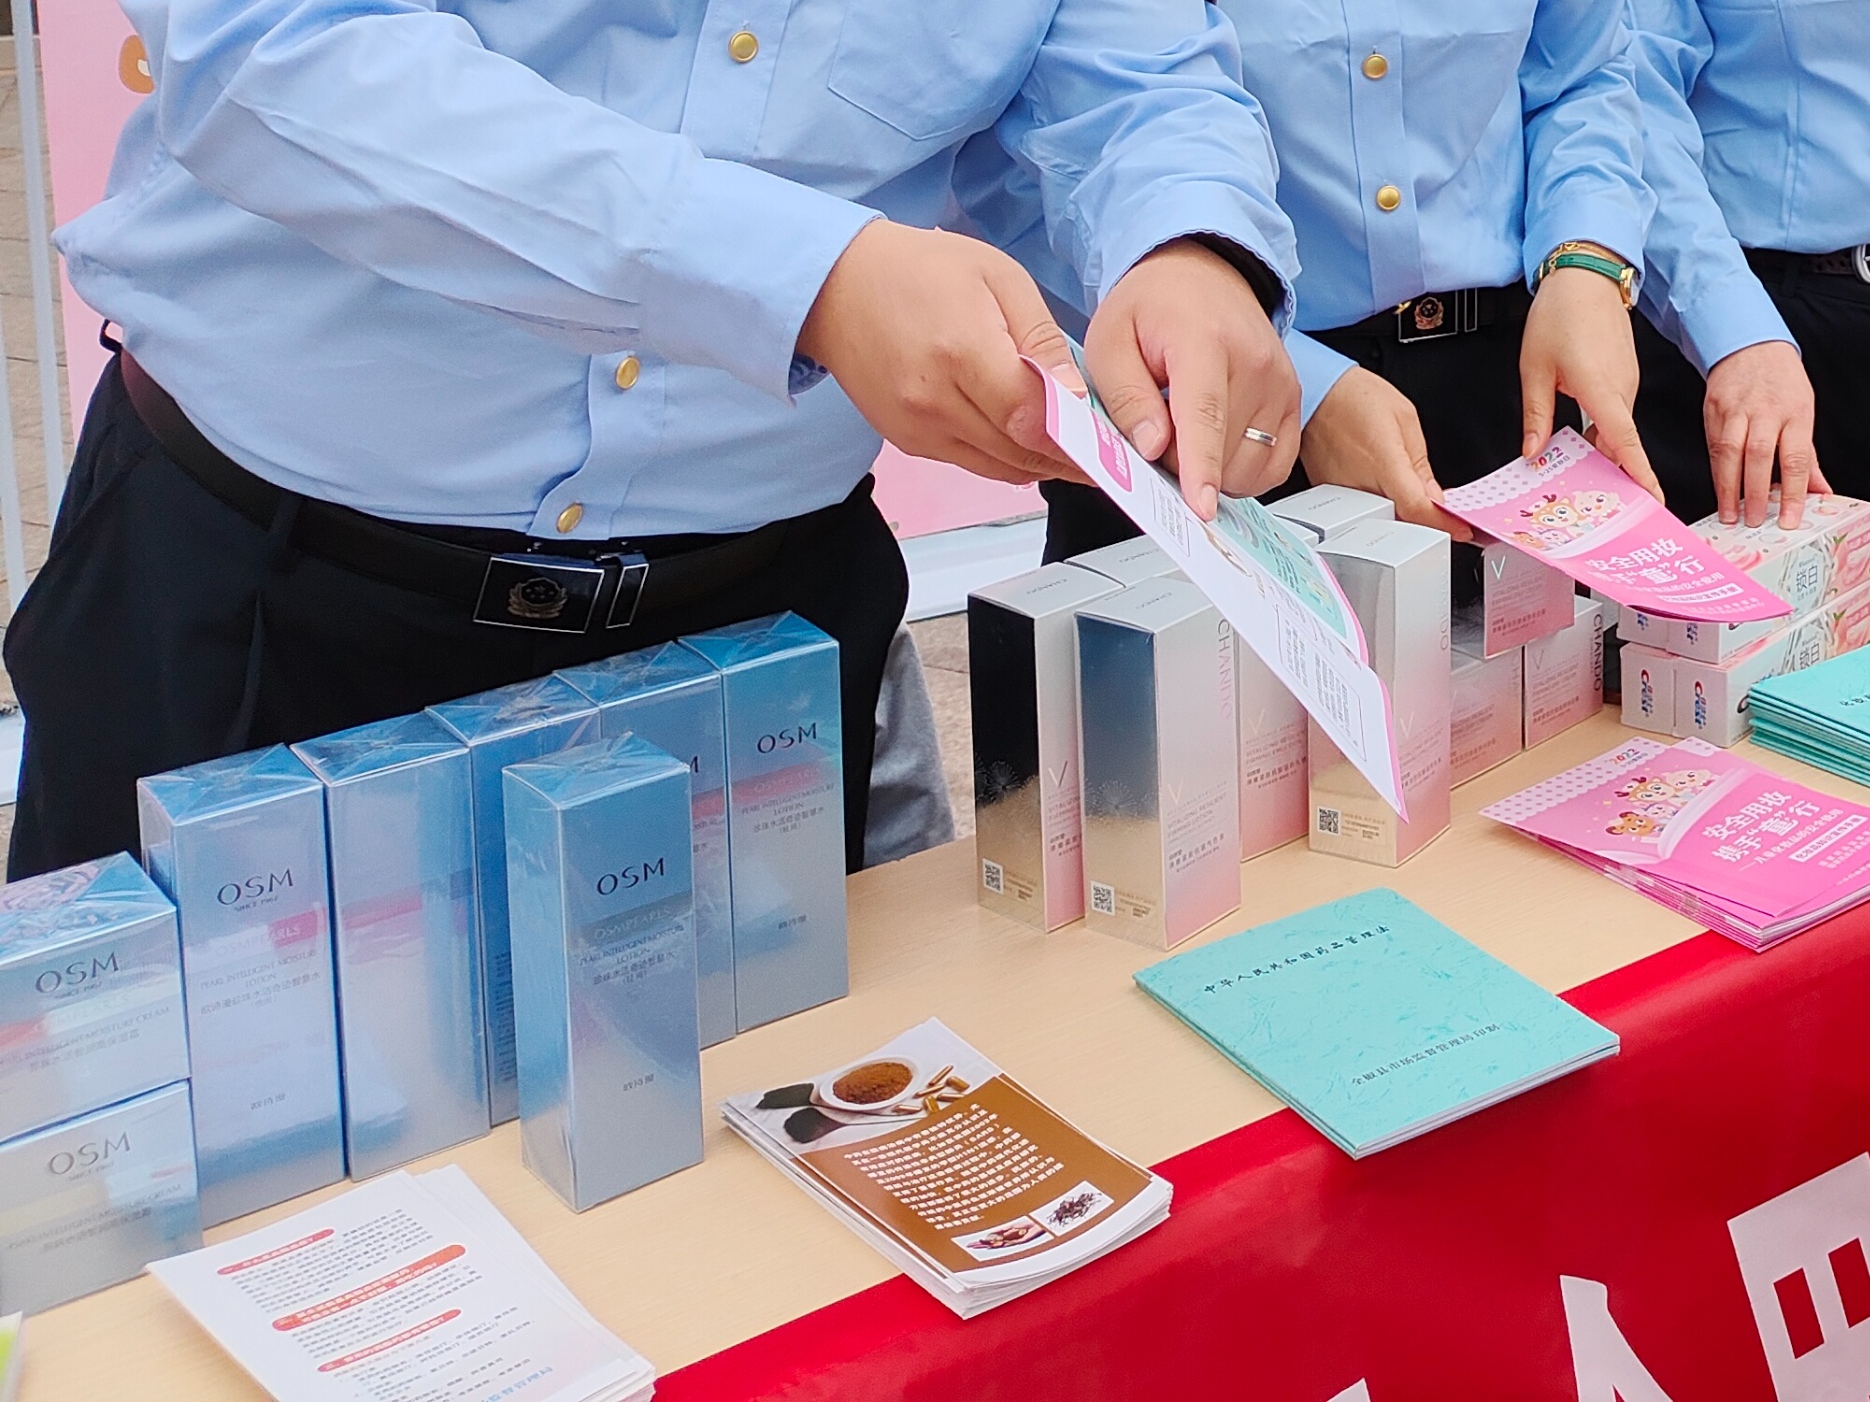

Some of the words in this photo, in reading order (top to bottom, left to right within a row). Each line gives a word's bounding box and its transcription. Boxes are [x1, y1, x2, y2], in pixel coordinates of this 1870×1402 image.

[1530, 446, 1564, 473] 2022
[1585, 537, 1683, 573] 安全用妆
[1796, 563, 1819, 591] 锁白
[1216, 618, 1232, 720] CHANDO
[1592, 613, 1603, 692] CHANDO
[1640, 668, 1651, 717] Crest
[1694, 680, 1704, 728] Crest
[757, 721, 818, 755] OSM
[1702, 789, 1793, 842] 安全用妆
[216, 867, 295, 906] OSM
[596, 856, 666, 897] OSM
[35, 950, 121, 994] OSM
[1203, 923, 1391, 995] 中华人民共和国药品管理法
[48, 1130, 132, 1176] OSM
